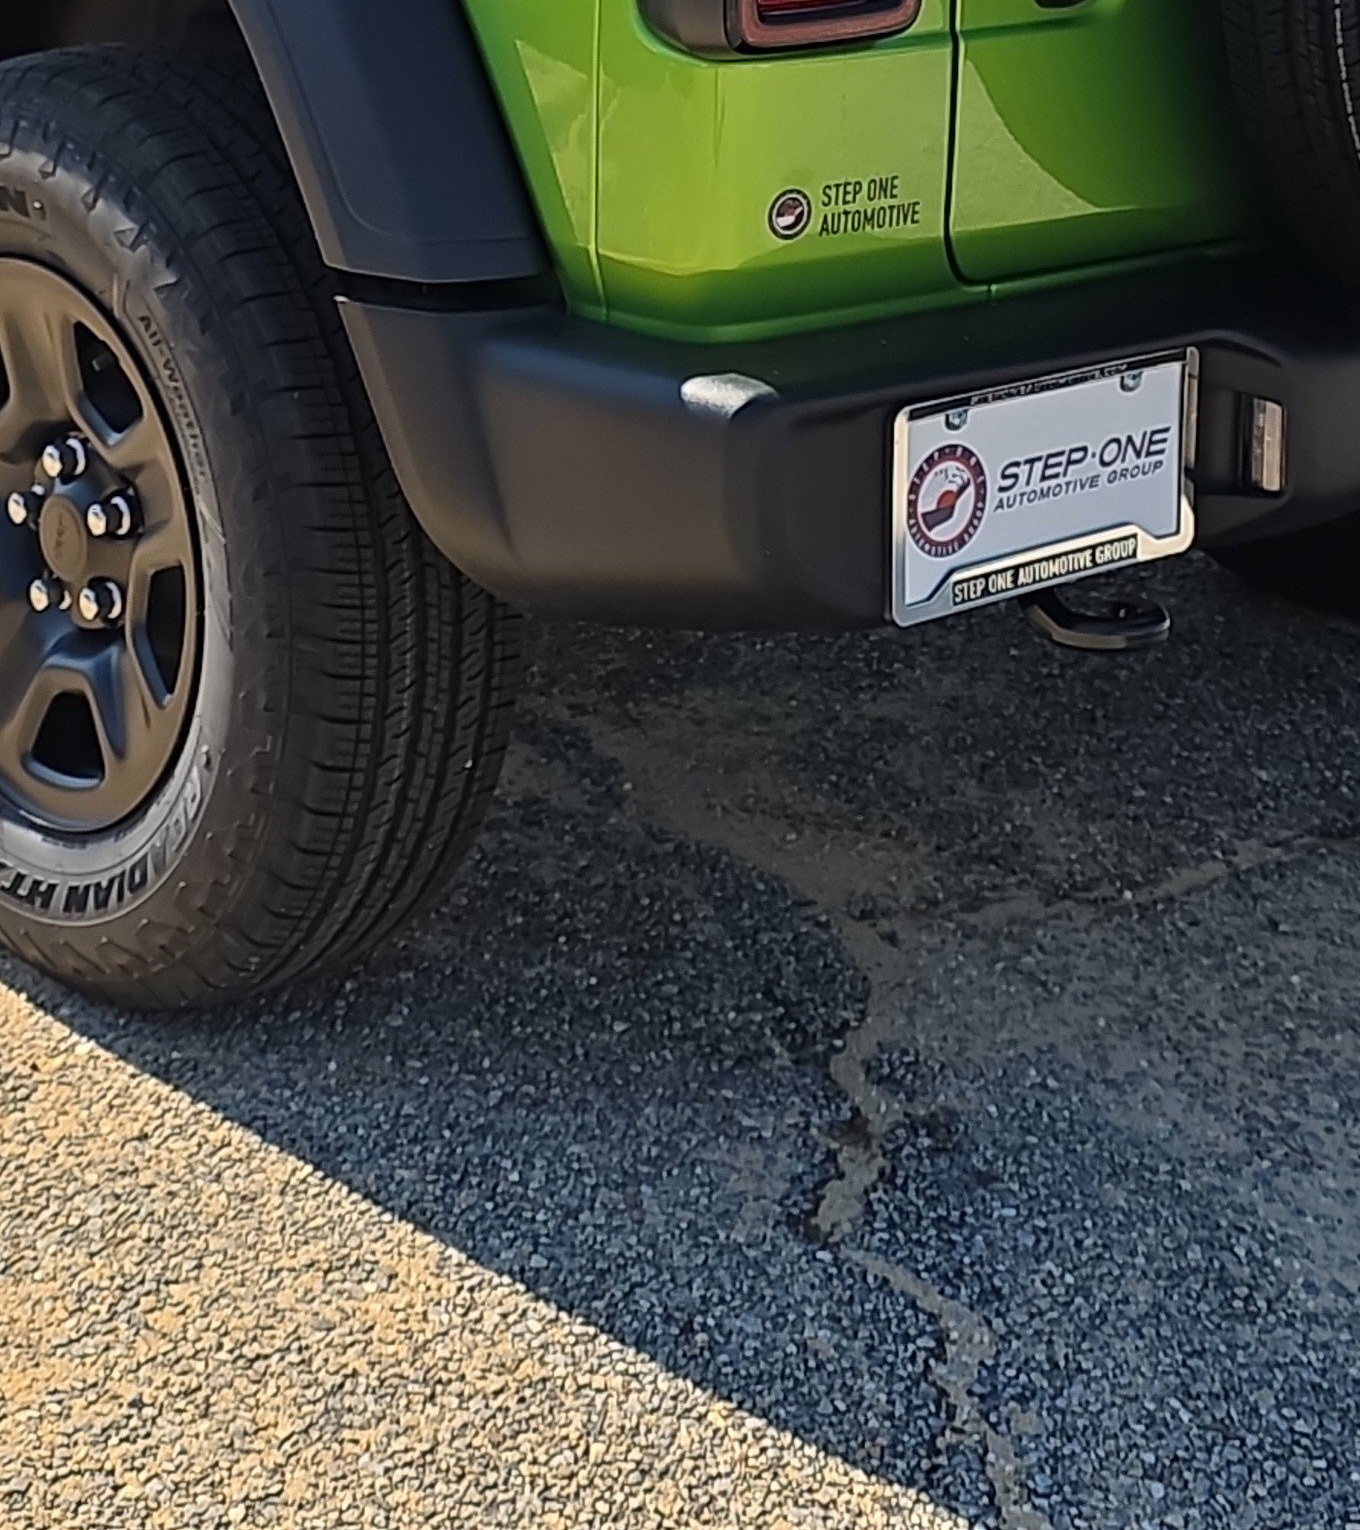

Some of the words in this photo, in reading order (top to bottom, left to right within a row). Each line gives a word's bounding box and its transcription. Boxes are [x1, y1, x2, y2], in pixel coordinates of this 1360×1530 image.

[821, 180, 862, 208] STEP
[867, 175, 900, 202] ONE
[818, 201, 921, 237] AUTOMOTIVE
[993, 475, 1101, 513] AUTOMOTIVE
[1106, 459, 1165, 485] GROUP
[953, 575, 985, 604] STEP
[988, 567, 1015, 594] ONE
[1016, 549, 1094, 587] AUTOMOTIVE
[1094, 535, 1138, 567] GROUP
